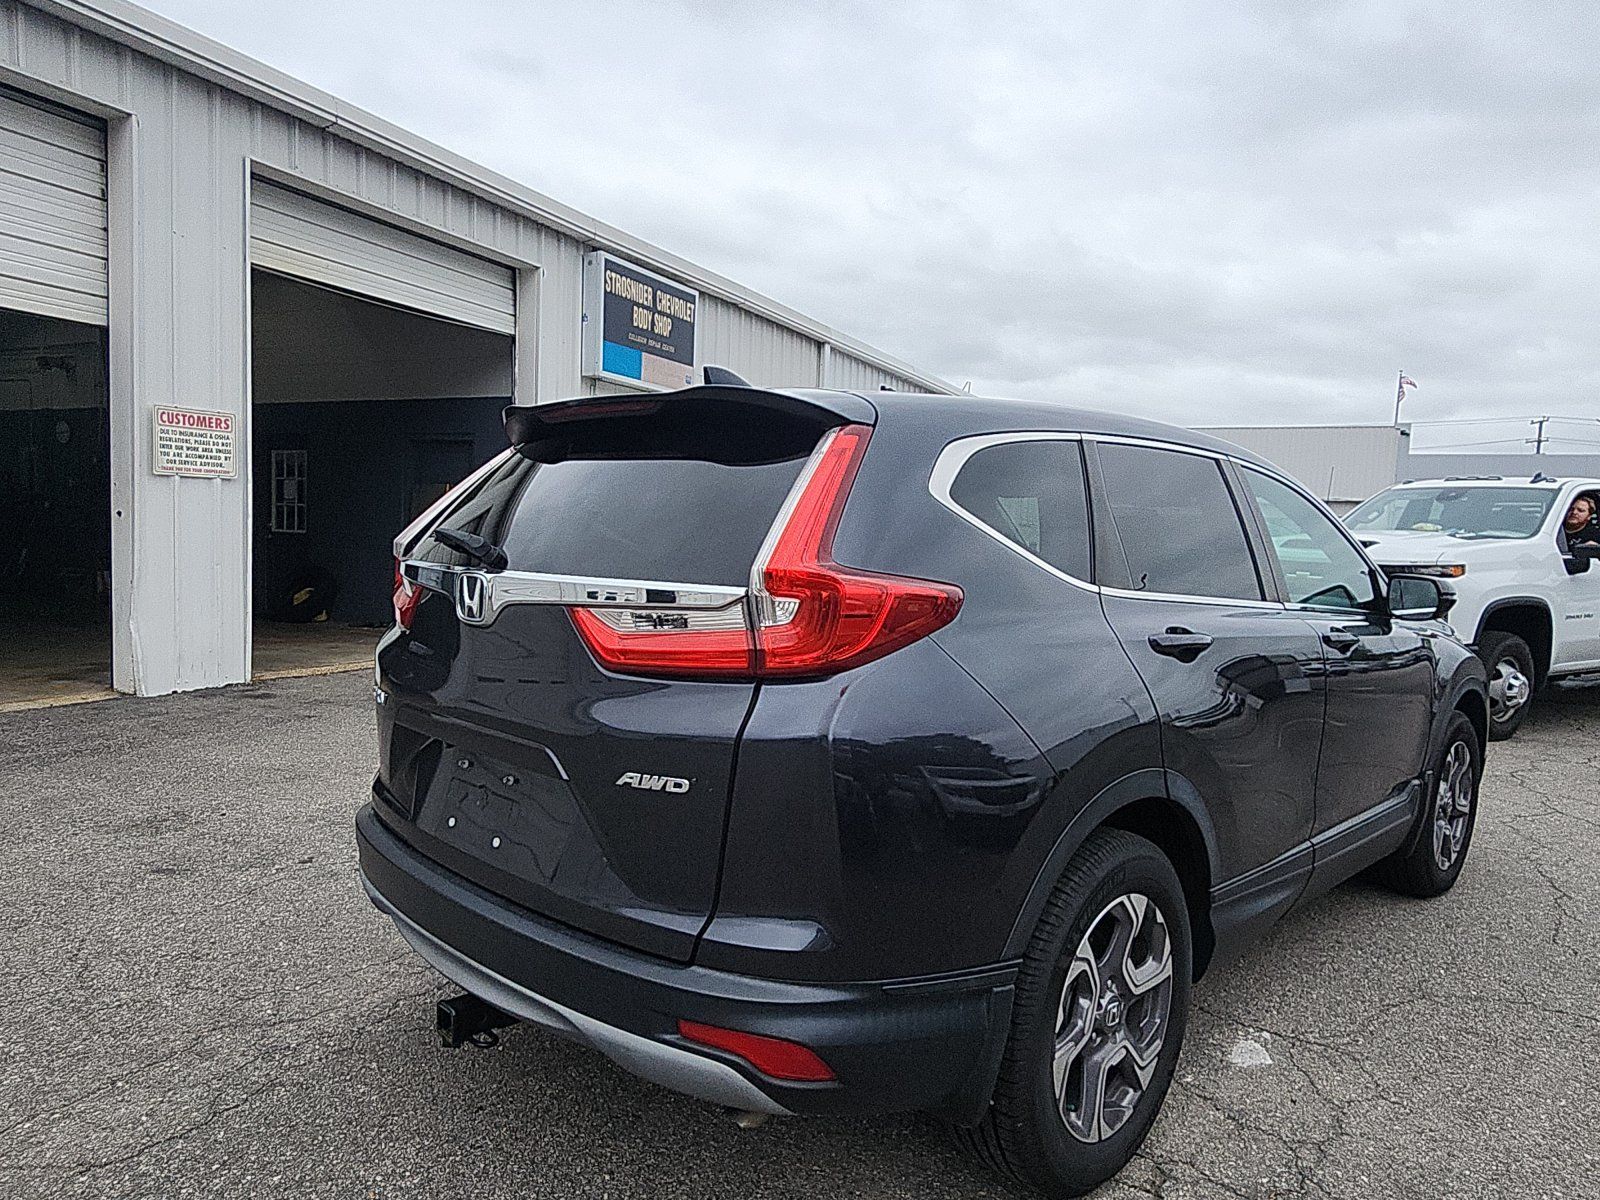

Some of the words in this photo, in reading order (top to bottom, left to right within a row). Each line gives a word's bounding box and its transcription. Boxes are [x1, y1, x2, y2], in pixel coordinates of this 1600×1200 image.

[606, 270, 653, 308] STROSNIDER
[656, 290, 695, 323] CHEVROLET
[633, 306, 652, 331] BODY
[654, 312, 672, 337] SHOP
[160, 411, 230, 430] CUSTOMERS
[159, 436, 193, 445] REGULATIONS,
[179, 430, 208, 439] INSURANCE
[616, 772, 690, 794] AWD
